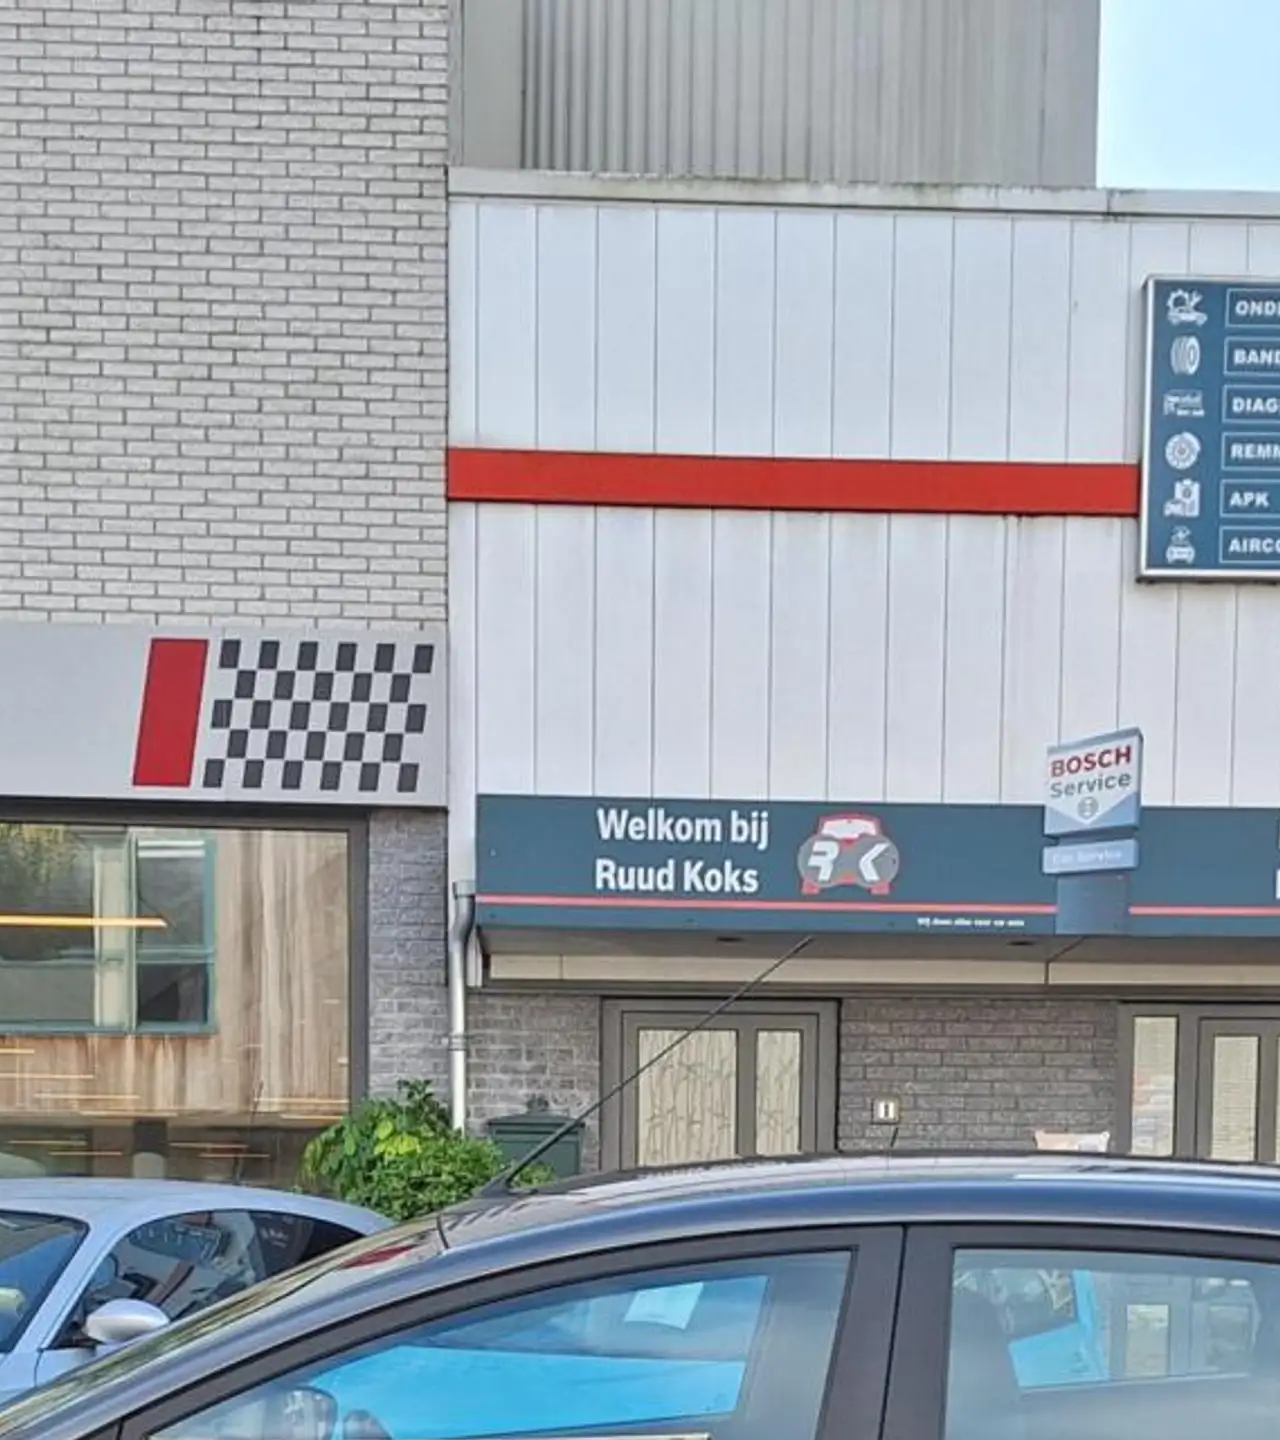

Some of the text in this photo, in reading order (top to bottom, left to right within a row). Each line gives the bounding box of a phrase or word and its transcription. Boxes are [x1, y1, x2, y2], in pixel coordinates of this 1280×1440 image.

[1229, 492, 1269, 507] APK
[1050, 744, 1132, 778] BOSCH
[1049, 772, 1132, 799] Service
[596, 807, 770, 851] Welkom bij
[595, 858, 759, 893] Ruud Koks
